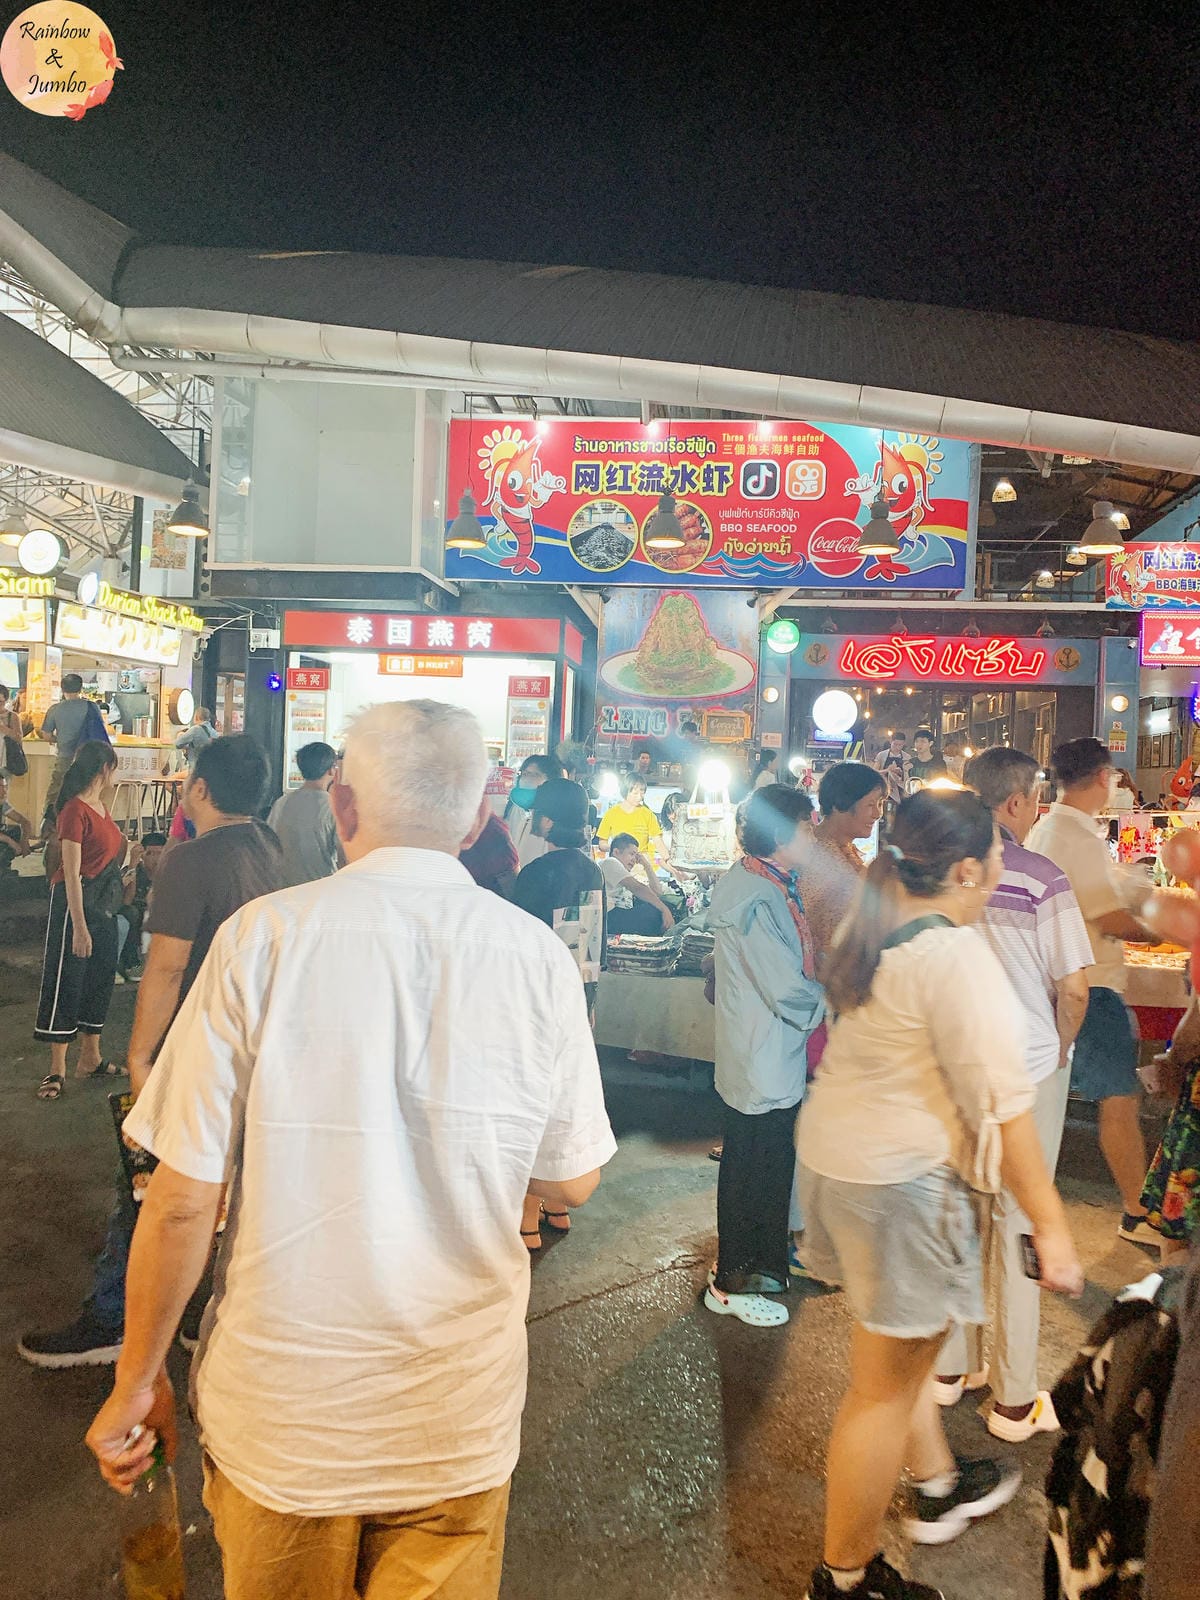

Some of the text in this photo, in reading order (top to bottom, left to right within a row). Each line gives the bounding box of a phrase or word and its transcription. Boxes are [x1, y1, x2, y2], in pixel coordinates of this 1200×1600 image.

[722, 433, 825, 443] Three fisrmen seafood
[572, 461, 733, 495] 网红流水虾
[720, 523, 798, 534] BBQ SEAFOOD
[1143, 551, 1200, 571] 网红流
[99, 580, 141, 615] Durian
[143, 596, 177, 624] Shack
[178, 606, 204, 632] Siam
[346, 615, 494, 649] 泰国燕窝
[601, 705, 669, 737] LENG
